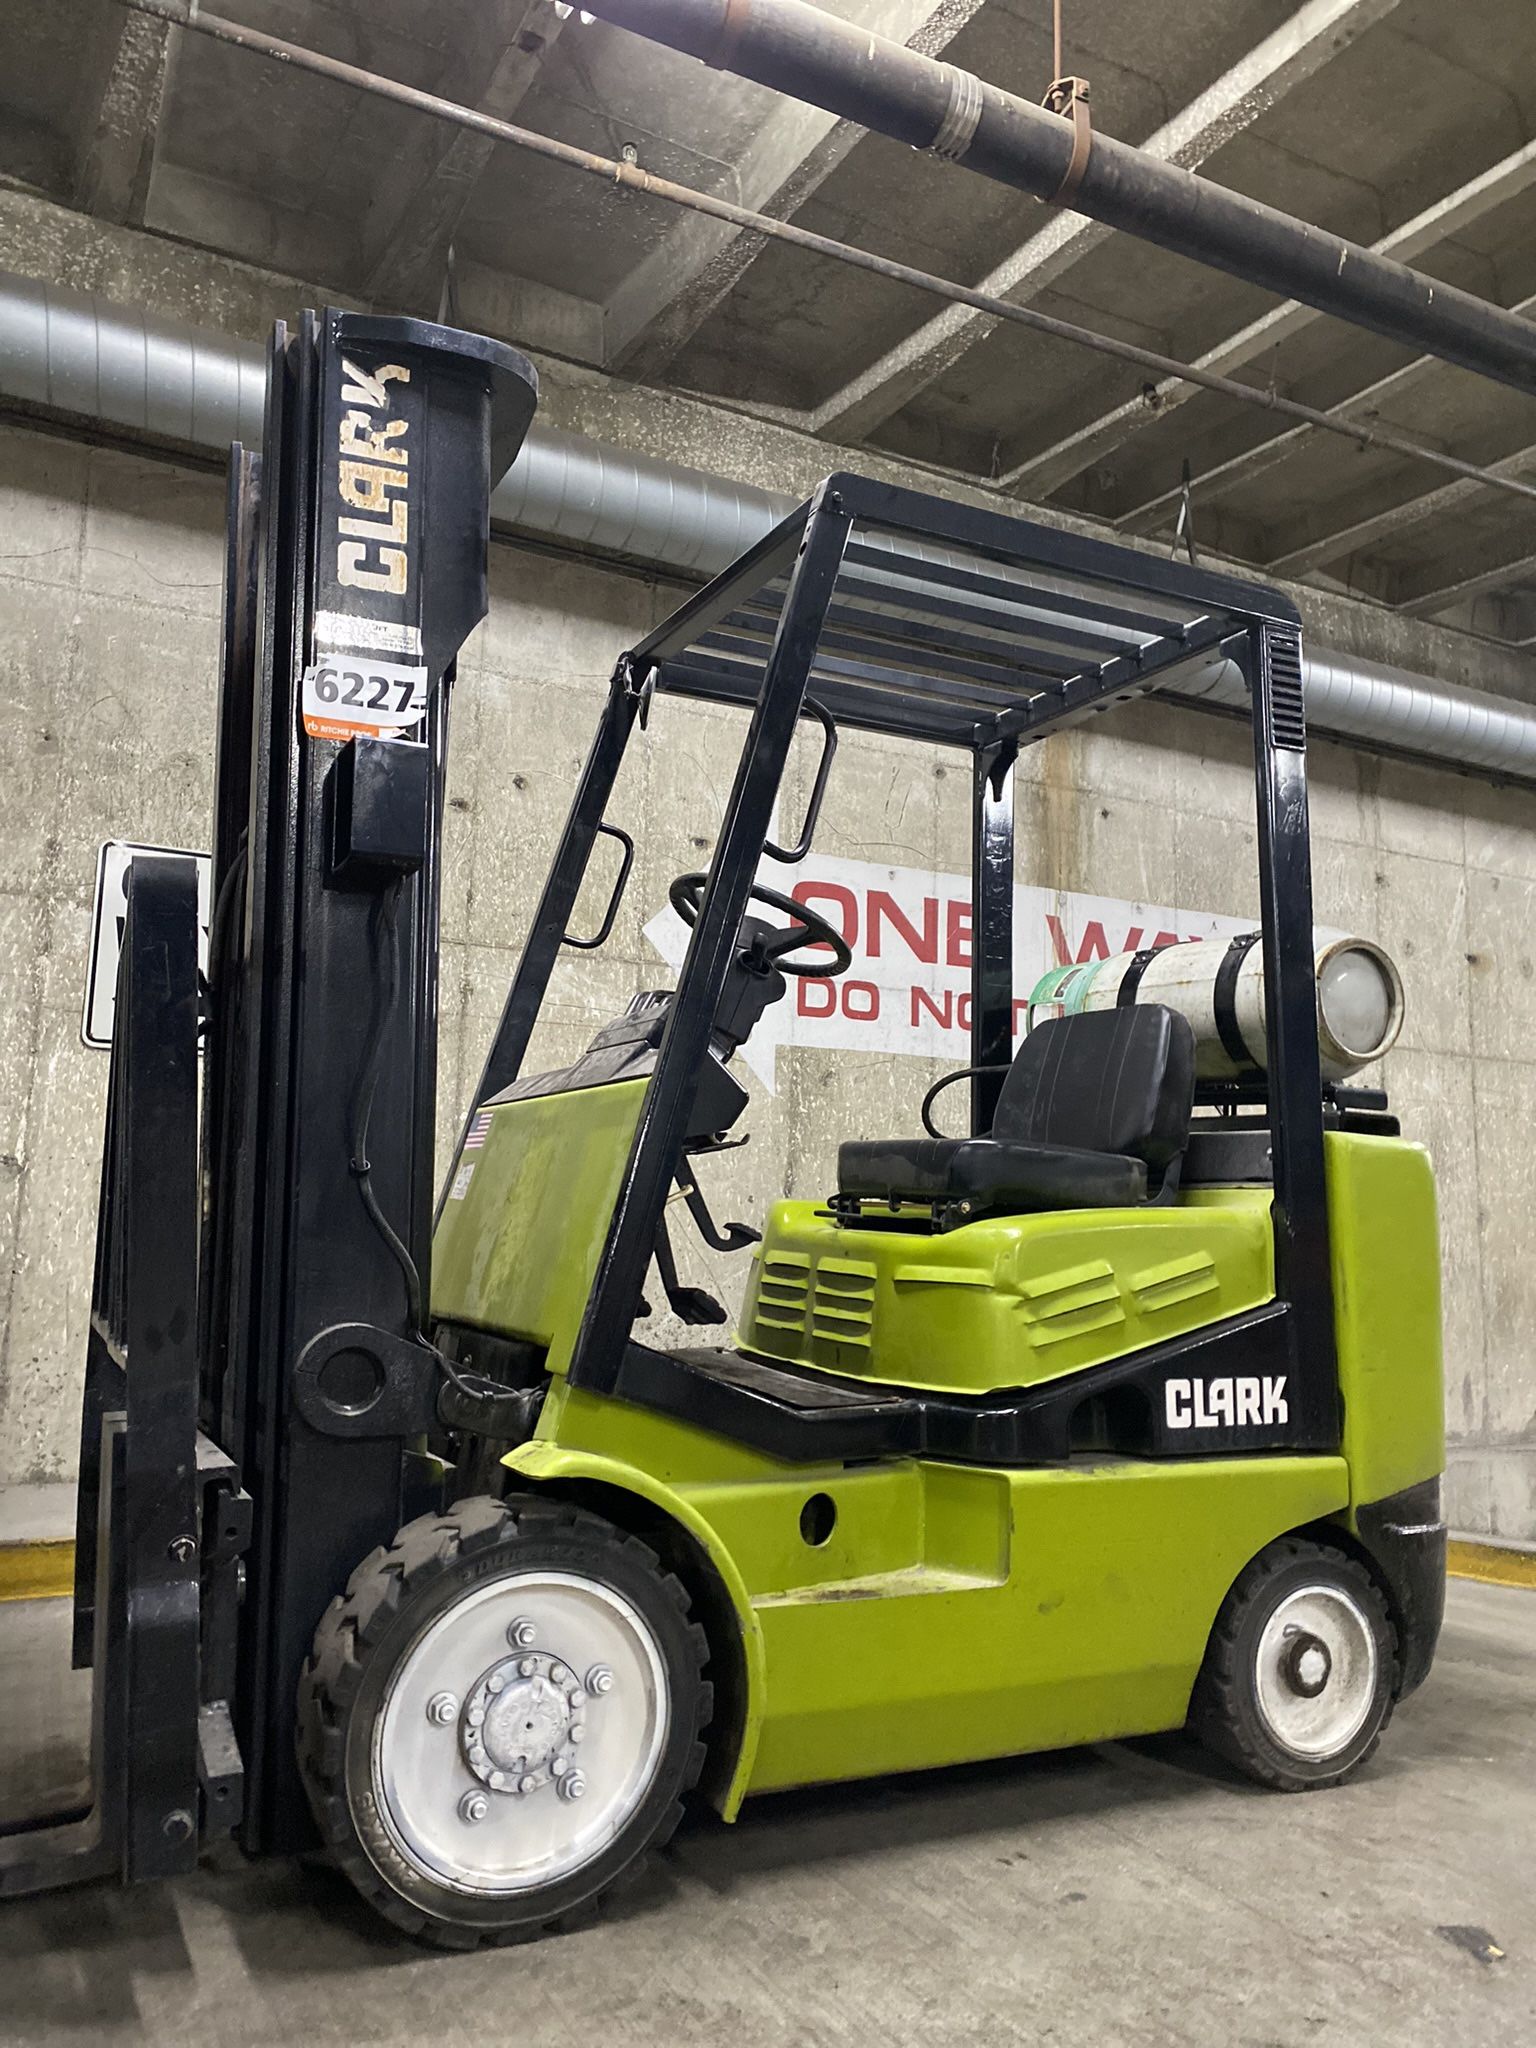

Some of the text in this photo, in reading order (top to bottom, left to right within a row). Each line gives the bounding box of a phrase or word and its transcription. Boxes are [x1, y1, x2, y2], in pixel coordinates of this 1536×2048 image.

[337, 357, 411, 595] CLARK
[315, 668, 415, 713] 6227
[798, 976, 880, 1021] DO
[1165, 1376, 1289, 1429] CLARK
